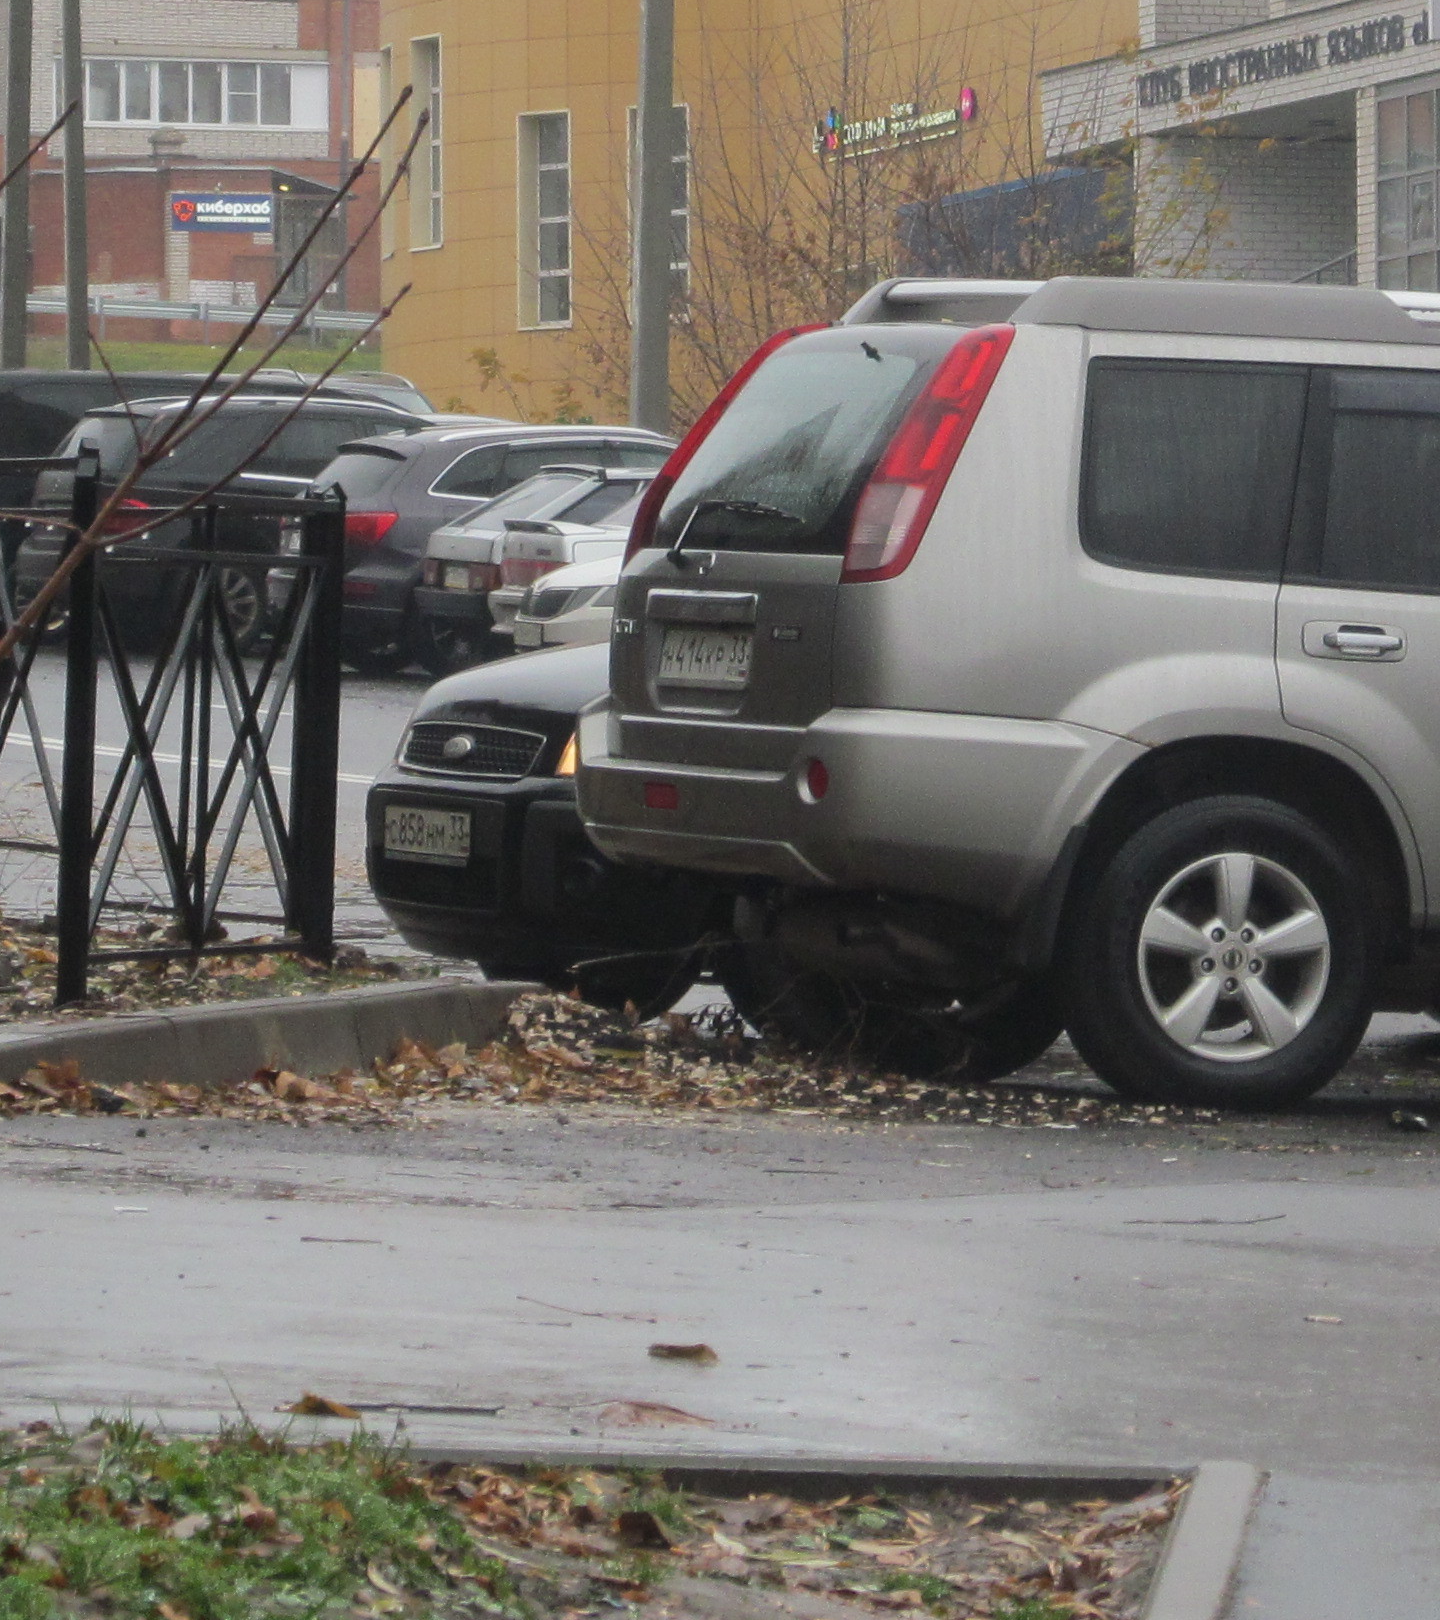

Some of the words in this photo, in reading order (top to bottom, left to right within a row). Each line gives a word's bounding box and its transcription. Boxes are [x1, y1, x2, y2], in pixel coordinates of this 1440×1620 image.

[1188, 34, 1319, 96] ИНОСТРАННЫХ
[1328, 13, 1405, 67] ЯЗЫКОВ
[196, 199, 271, 217] киберхаб
